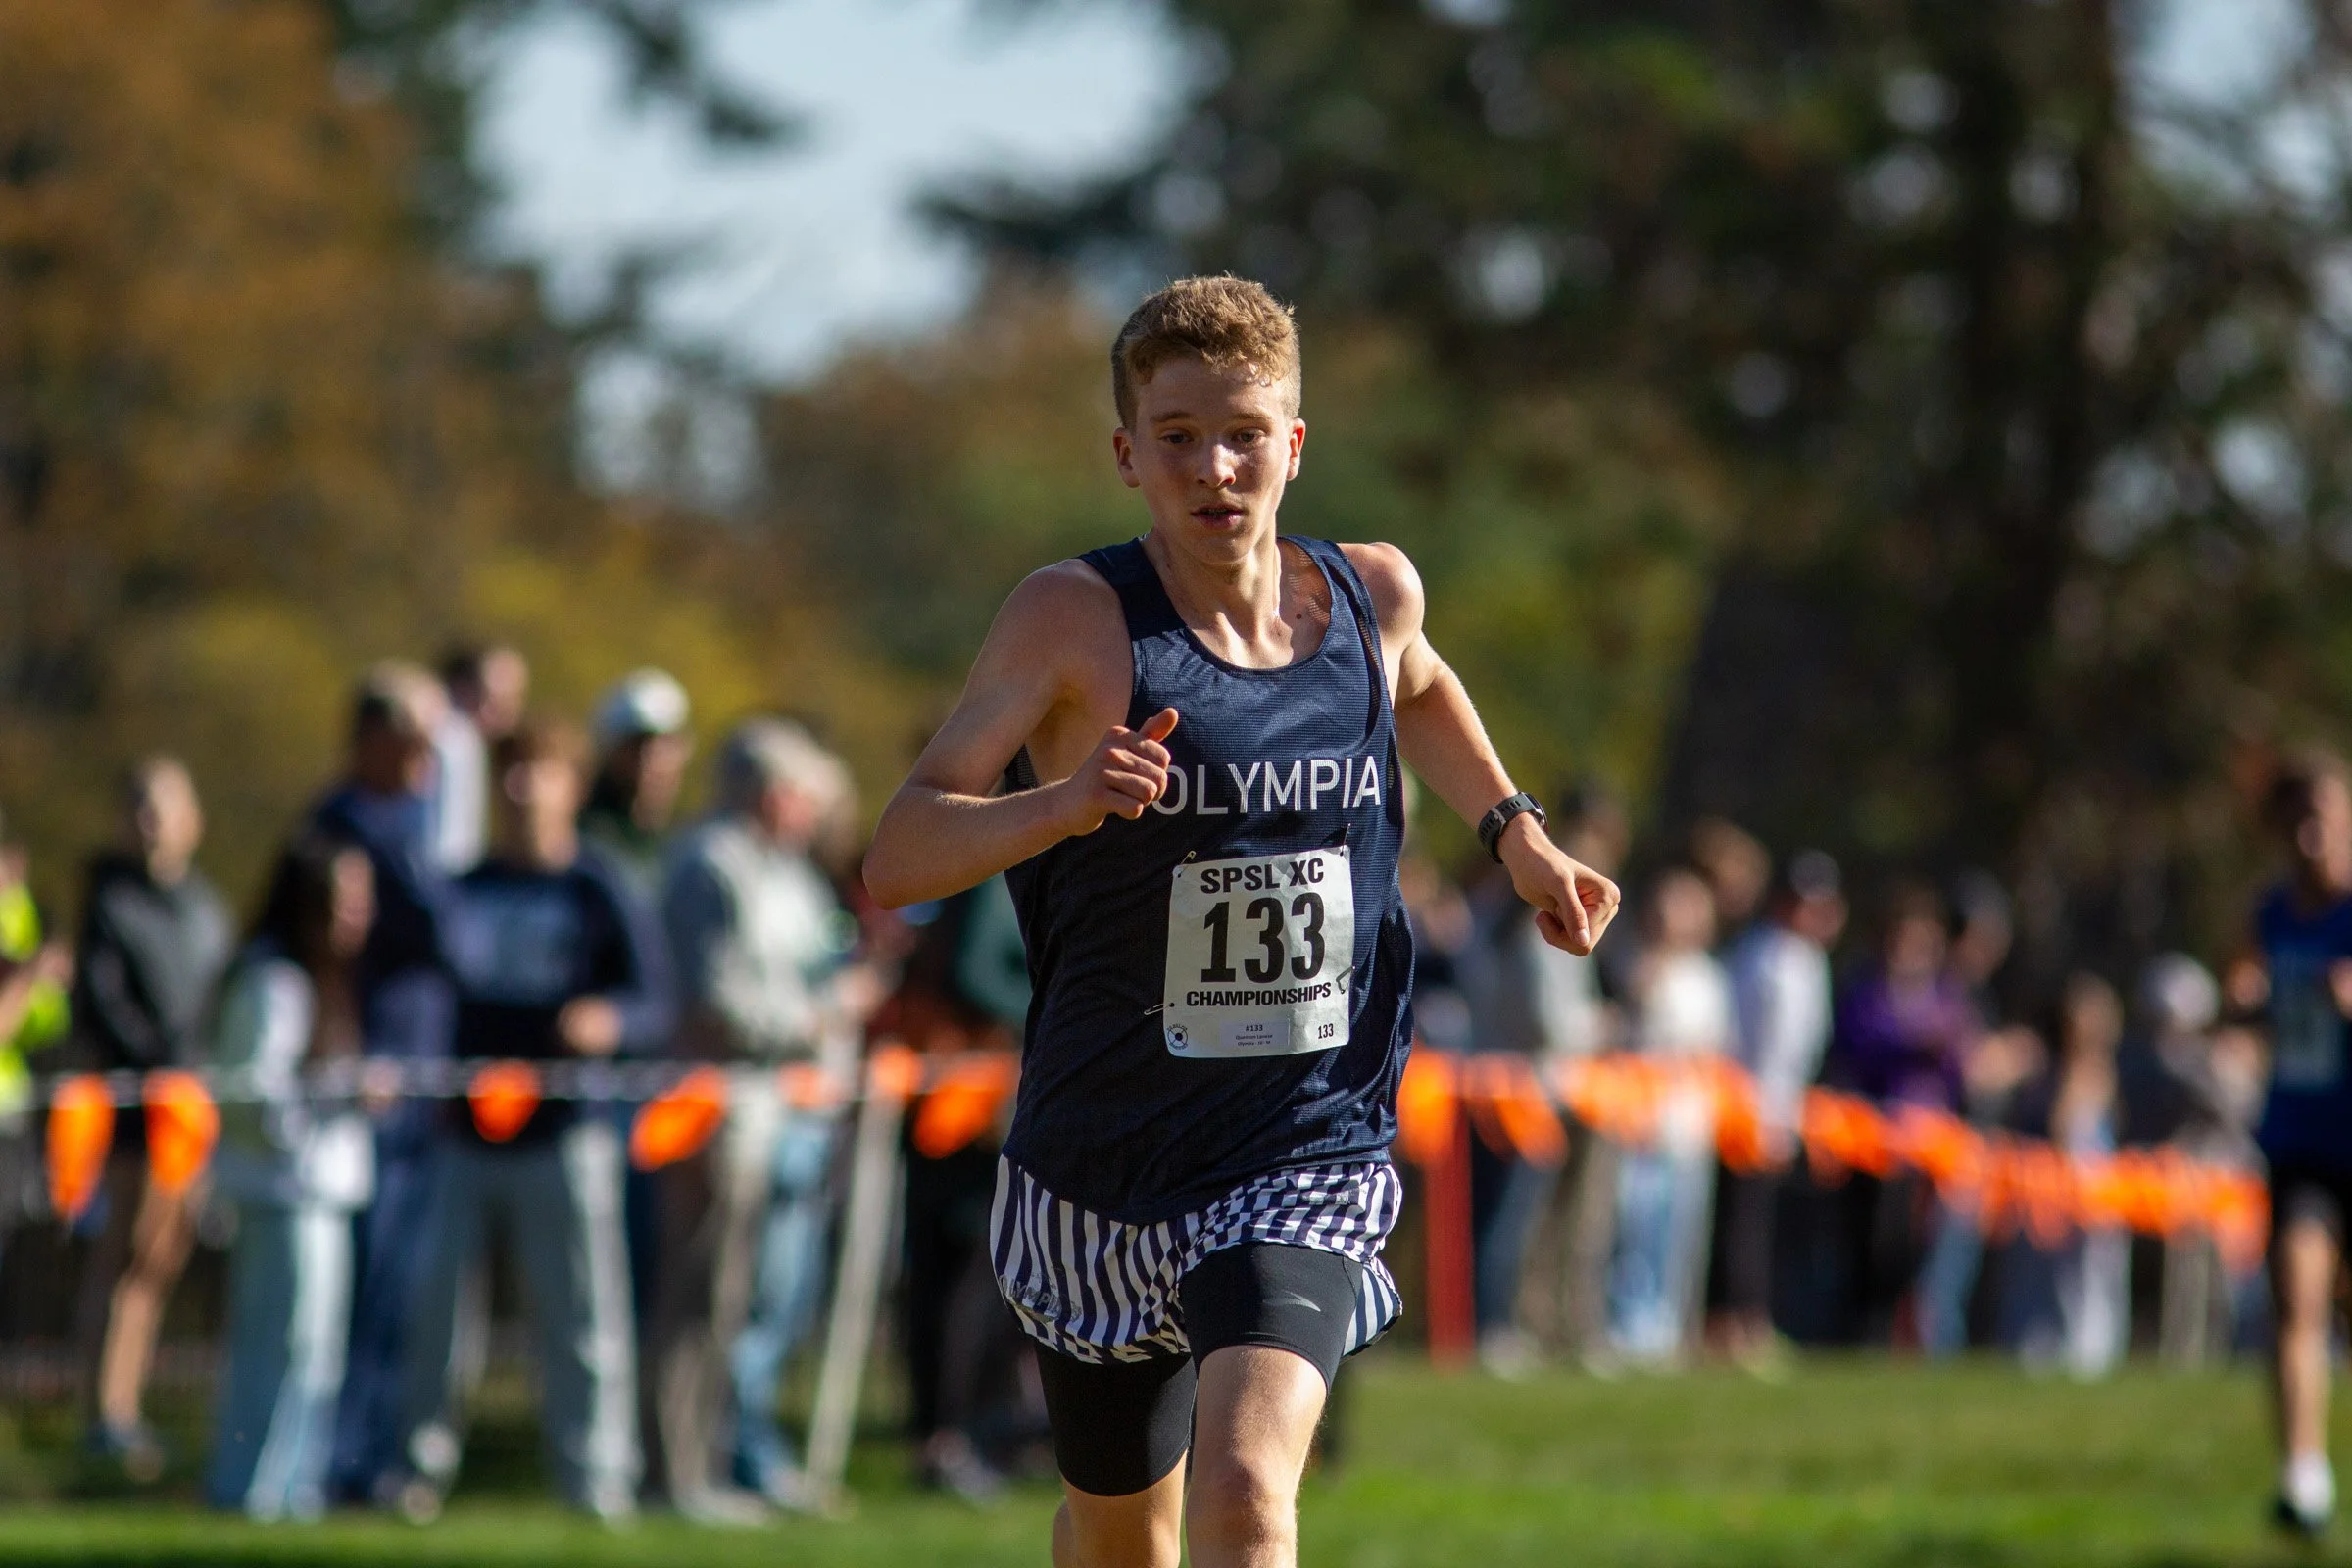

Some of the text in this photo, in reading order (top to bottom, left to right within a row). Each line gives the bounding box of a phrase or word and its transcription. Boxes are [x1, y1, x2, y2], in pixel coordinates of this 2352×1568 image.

[1152, 755, 1381, 815] OLYMPIA
[1200, 858, 1324, 894] SPSL XC
[1200, 892, 1325, 984] 133
[1186, 982, 1331, 1007] CHAMPIONSHIPS
[1317, 1023, 1334, 1040] 133
